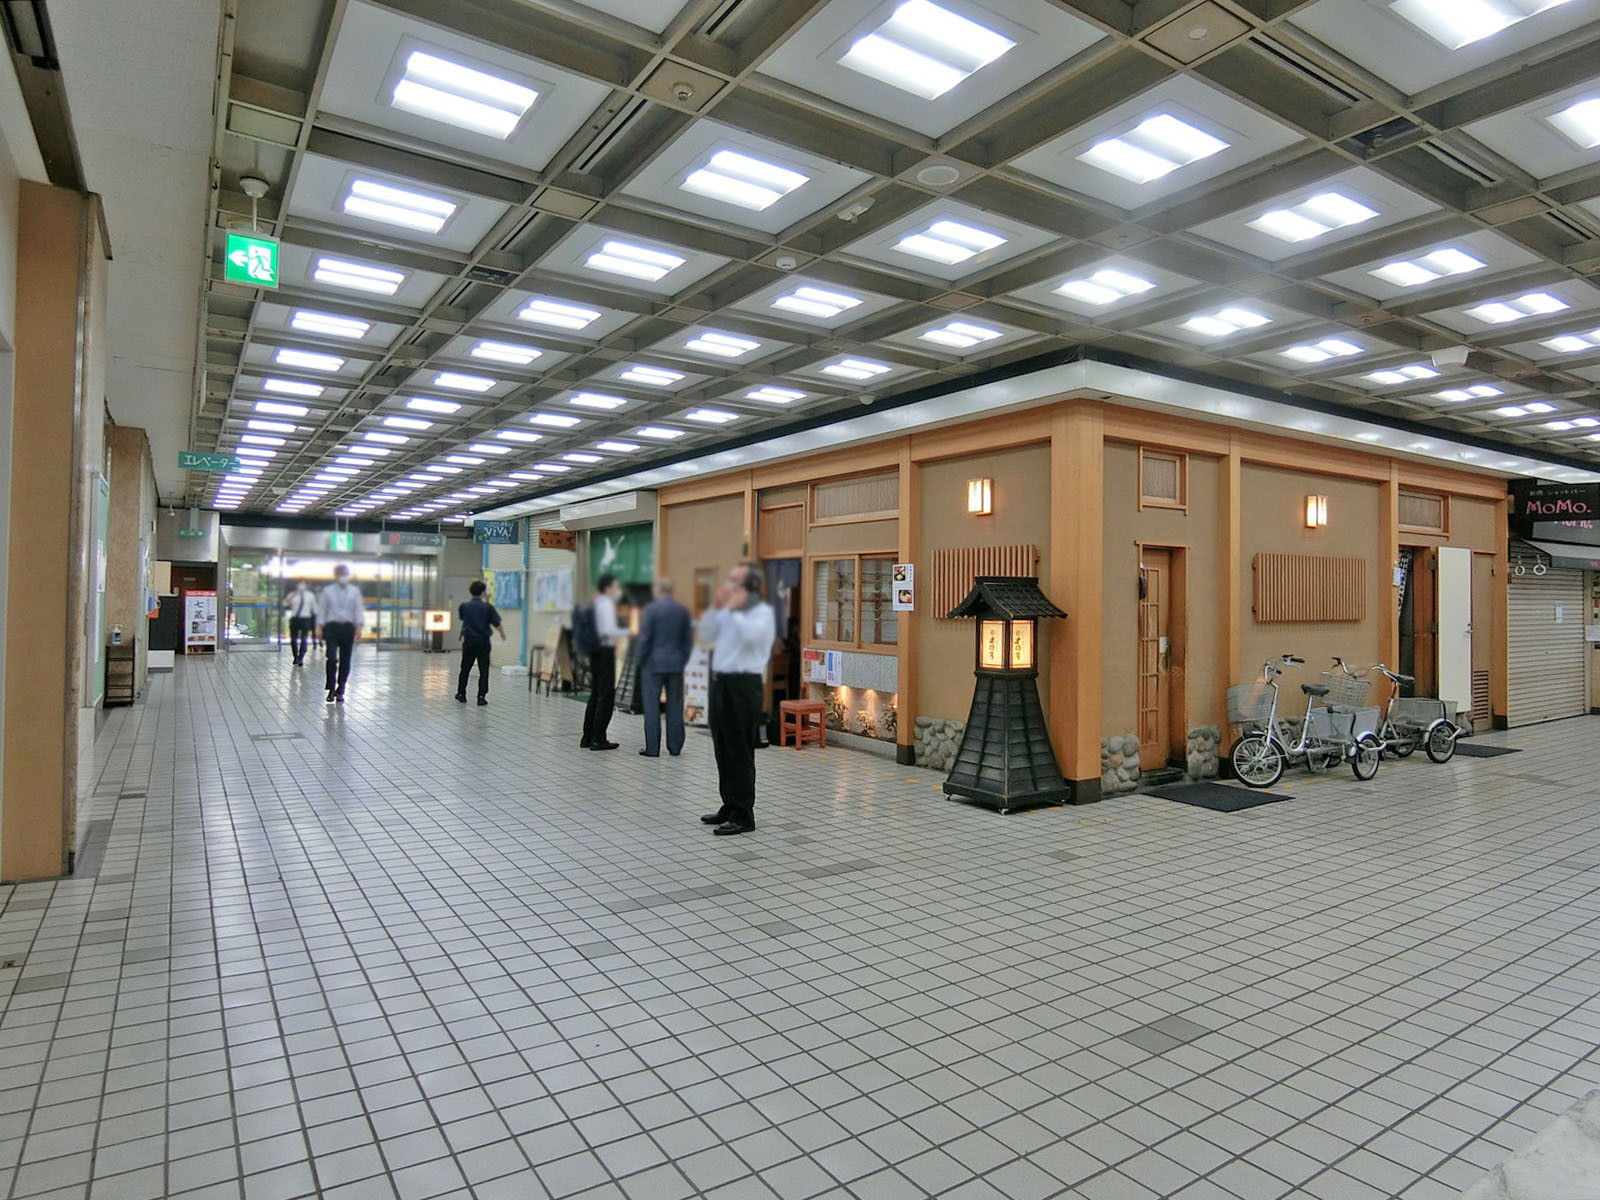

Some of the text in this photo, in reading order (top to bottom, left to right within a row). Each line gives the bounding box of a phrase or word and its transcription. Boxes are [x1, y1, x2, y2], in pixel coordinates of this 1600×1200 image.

[183, 454, 237, 468] エレベーター
